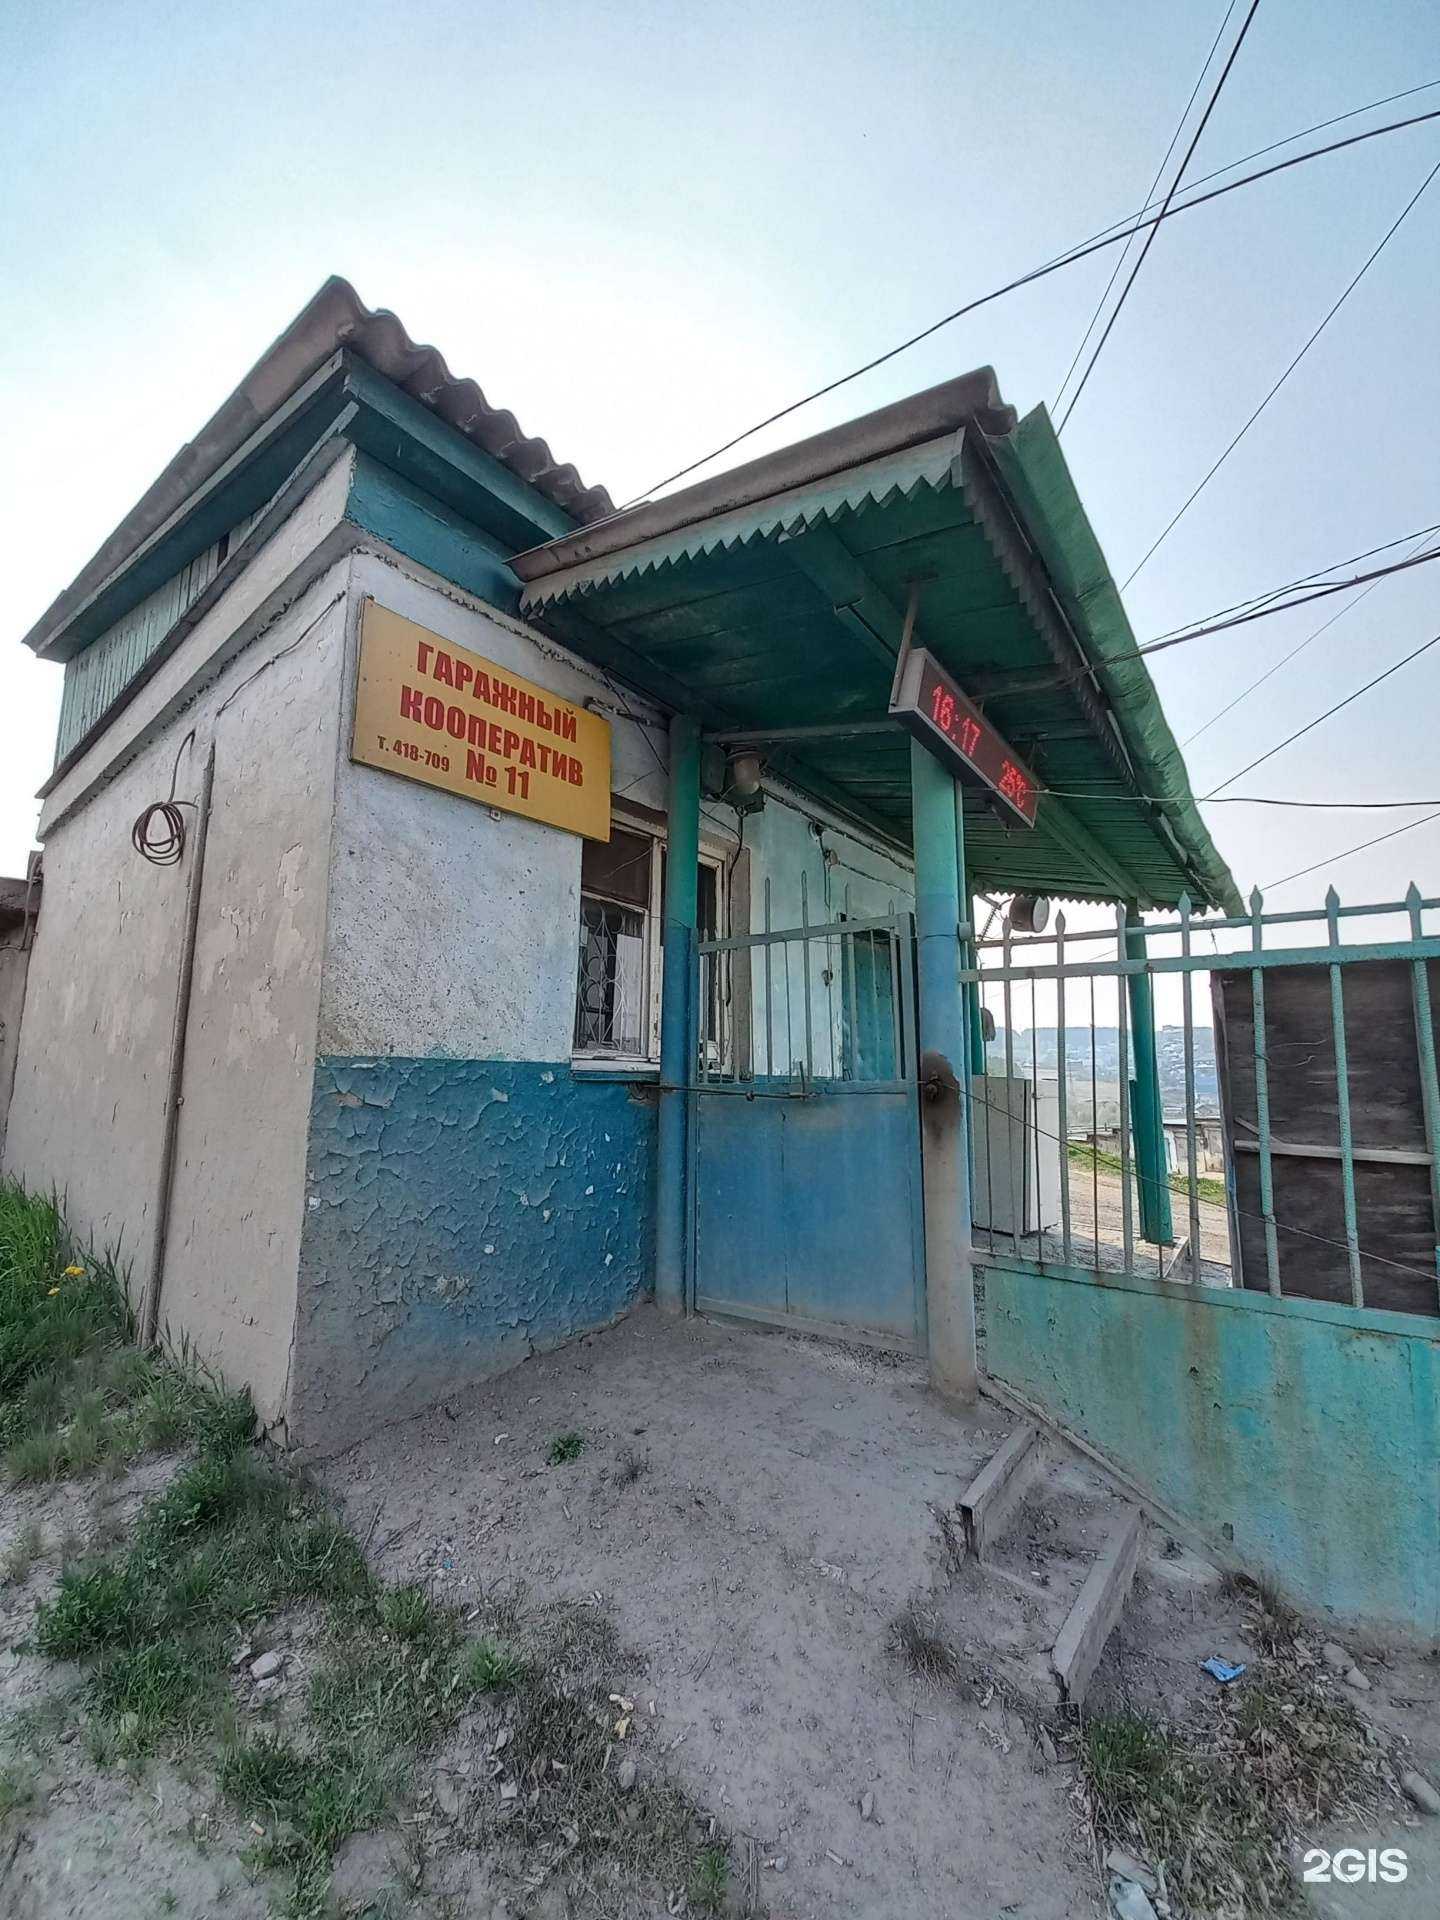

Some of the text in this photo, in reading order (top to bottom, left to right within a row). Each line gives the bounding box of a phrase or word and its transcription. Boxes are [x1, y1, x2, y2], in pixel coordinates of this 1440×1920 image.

[417, 641, 577, 743] ГАРАЖНЫЙ
[393, 739, 450, 773] 418-709
[400, 685, 584, 787] КООПЕРАТИВ
[465, 749, 530, 800] № 11
